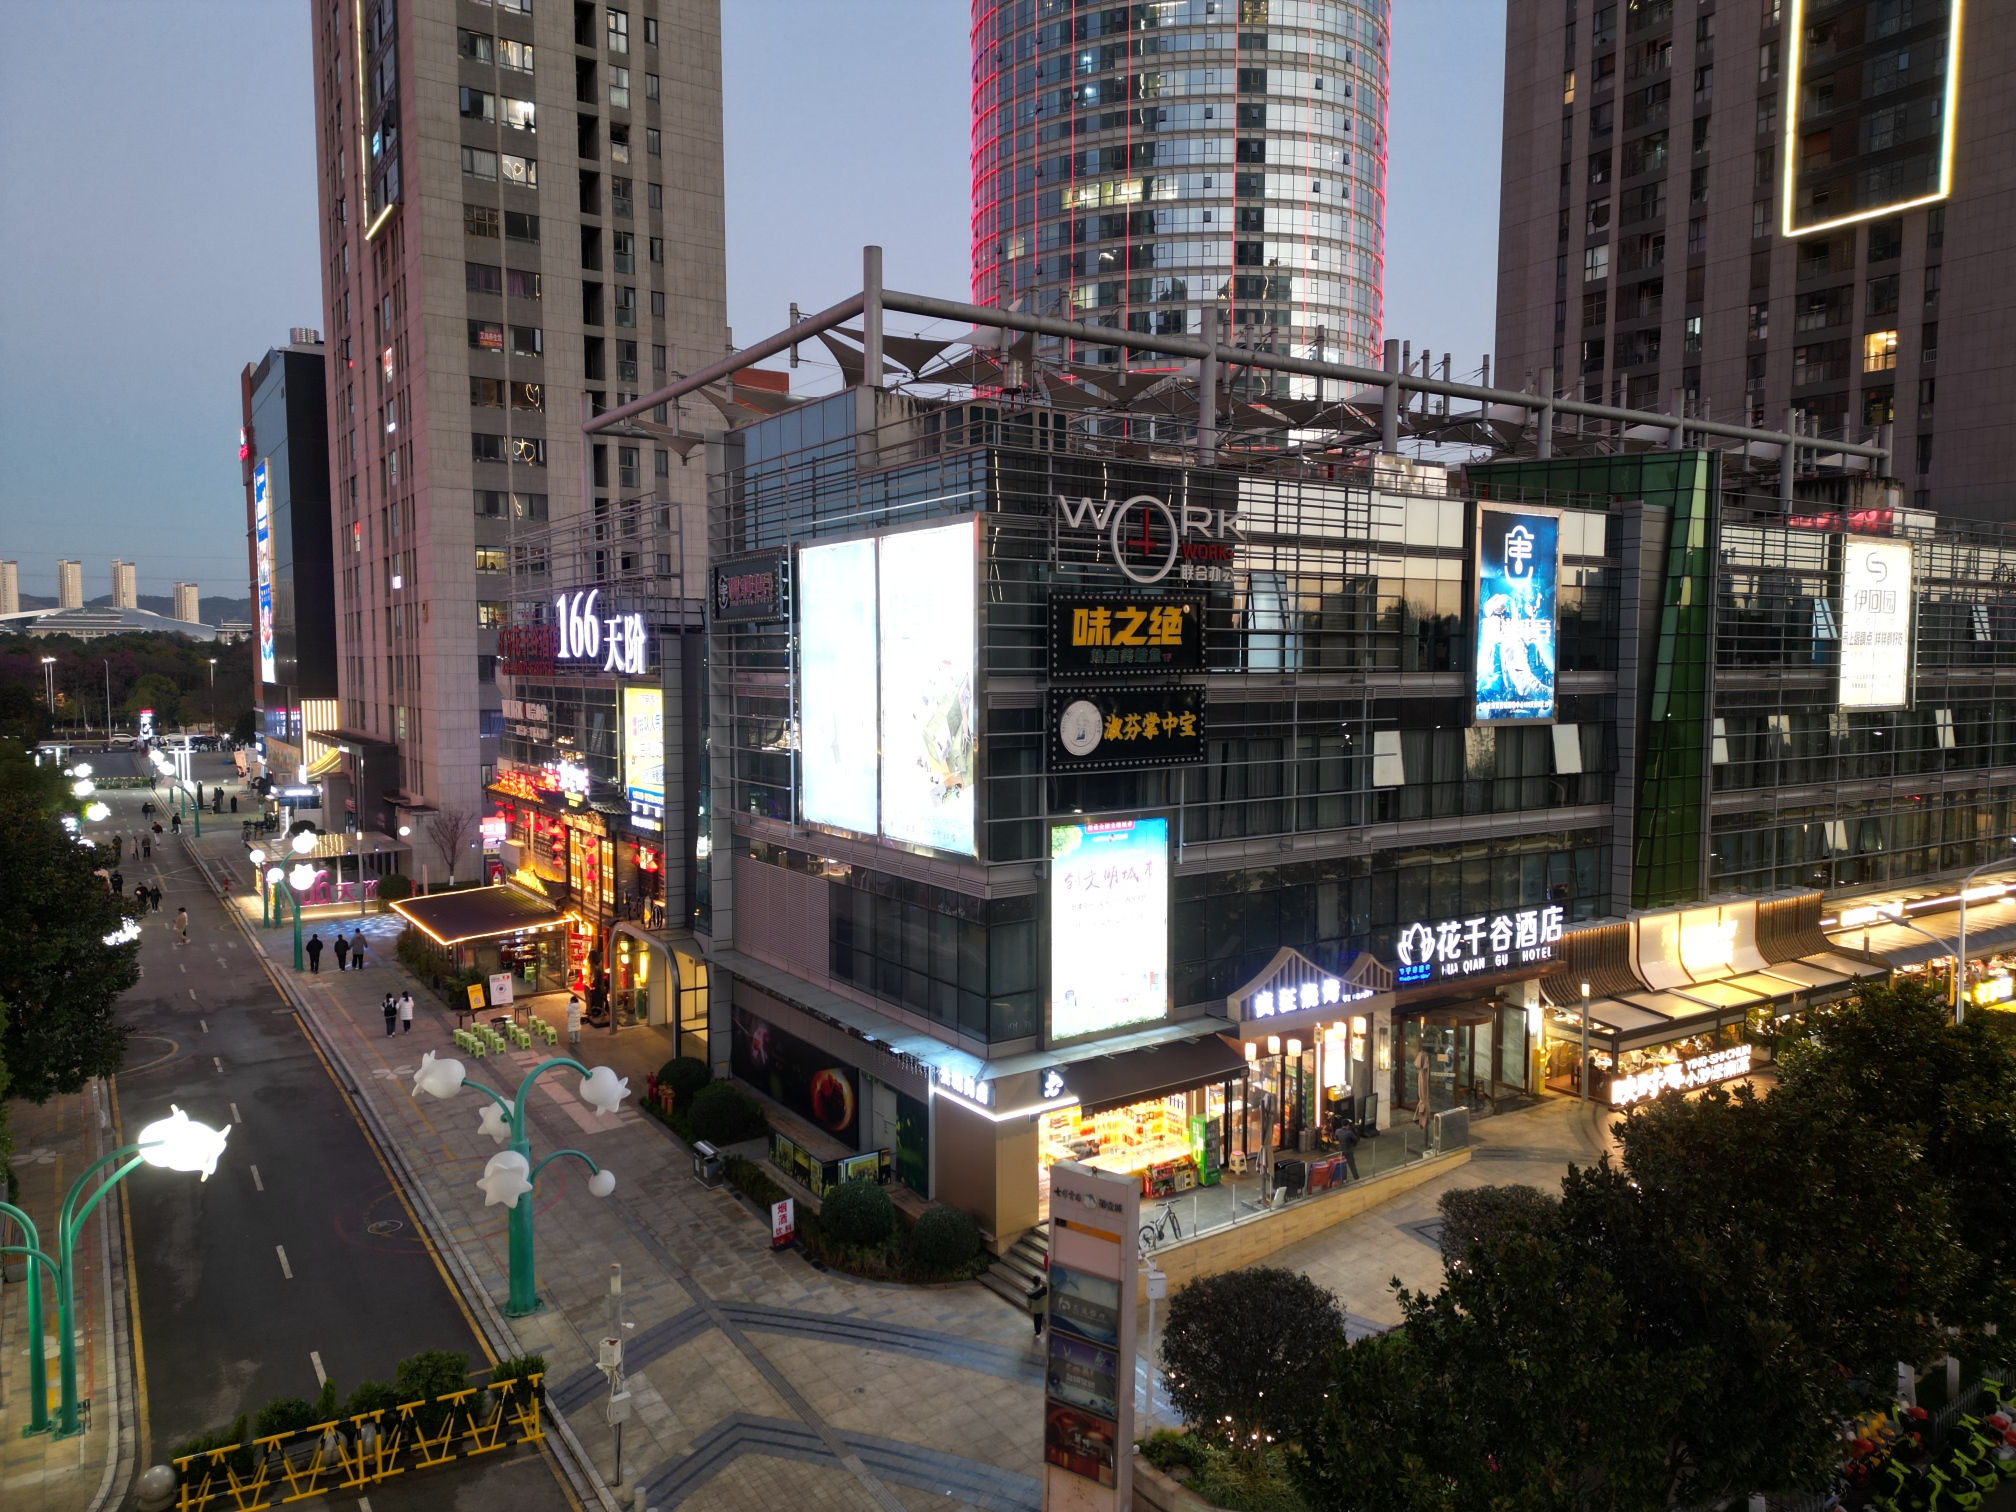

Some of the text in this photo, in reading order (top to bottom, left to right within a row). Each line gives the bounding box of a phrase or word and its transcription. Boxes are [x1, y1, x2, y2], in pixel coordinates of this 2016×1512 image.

[1056, 495, 1247, 584] WORK
[1180, 564, 1236, 583] 联合办公
[556, 588, 649, 675] 166 天阶
[1072, 605, 1184, 647] 味之绝
[1104, 710, 1197, 742] 淑芬掌中宝
[1436, 905, 1564, 963] 花千谷酒店
[1463, 957, 1486, 975] QIAN
[1495, 953, 1509, 968] GU
[1522, 945, 1553, 962] HOTEL
[775, 1224, 792, 1236] 饮料
[777, 1202, 788, 1226] 烟酒
